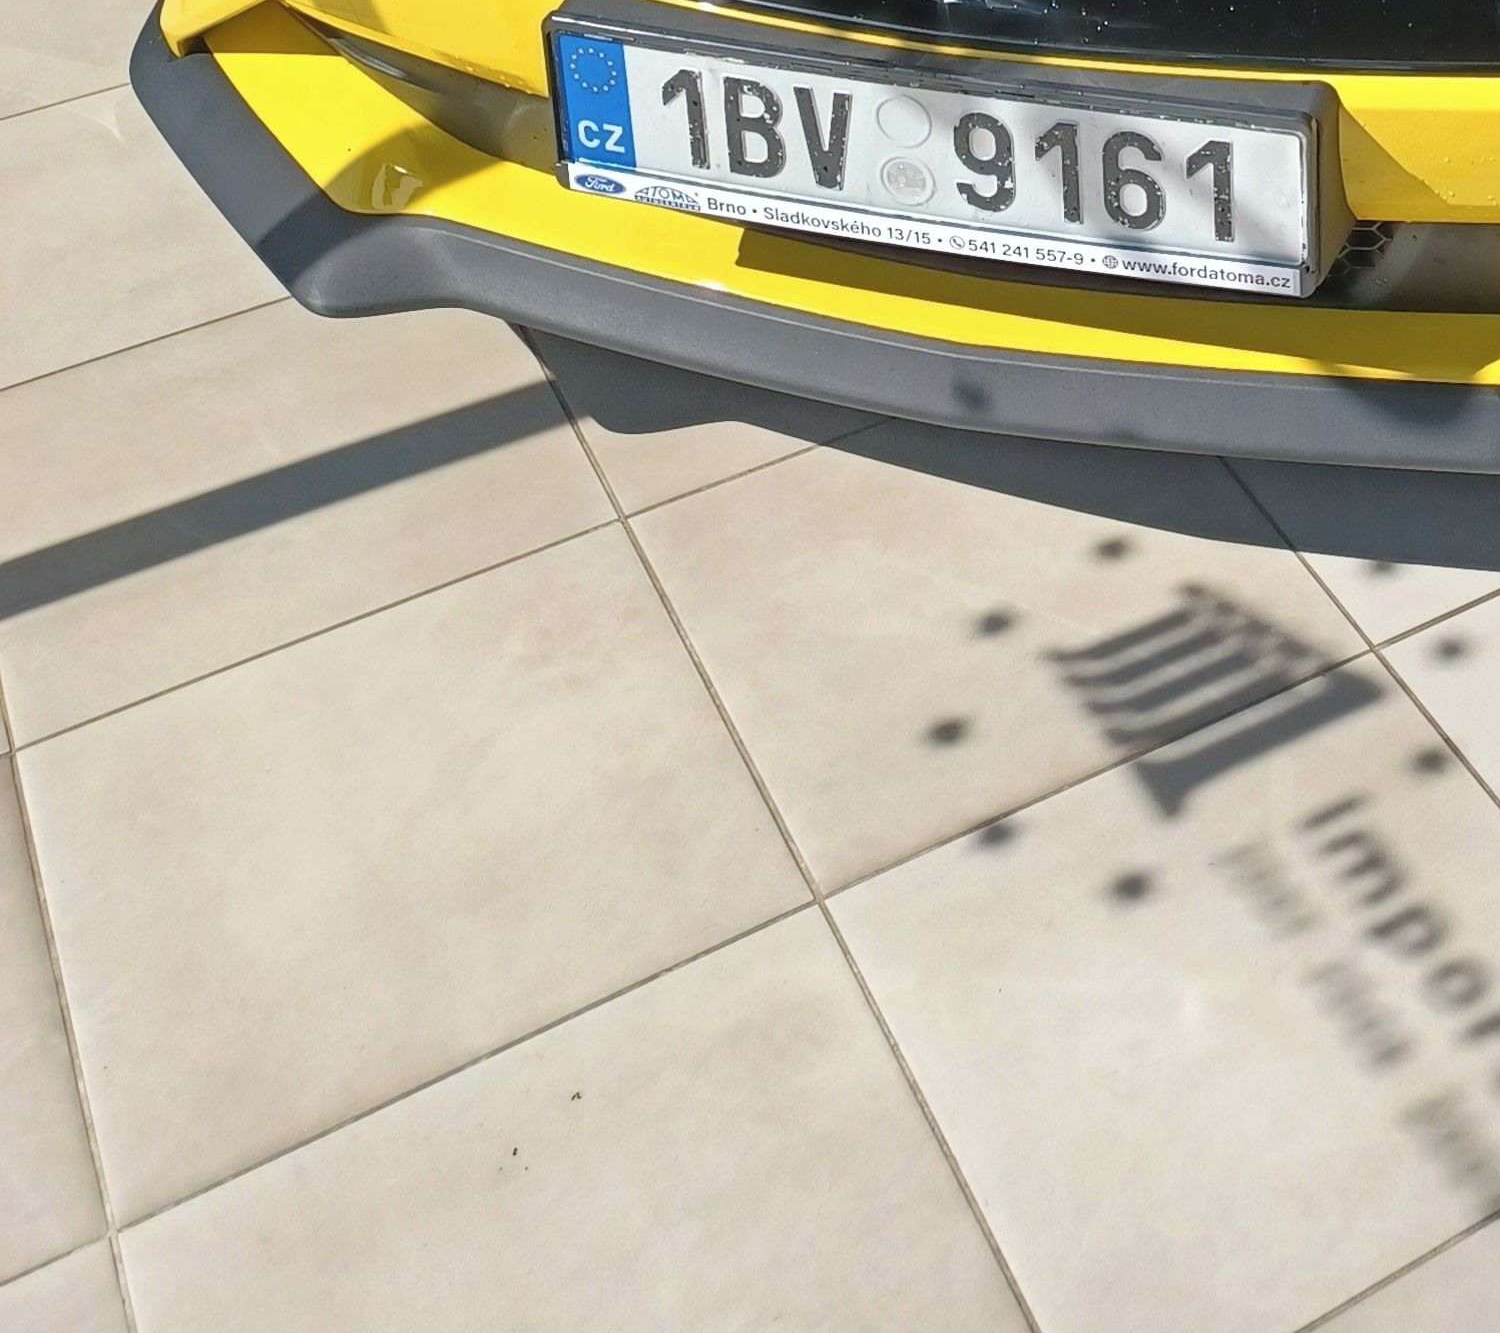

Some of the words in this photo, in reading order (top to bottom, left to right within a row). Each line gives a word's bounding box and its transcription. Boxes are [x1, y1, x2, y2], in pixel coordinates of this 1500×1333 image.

[577, 119, 626, 154] CZ
[662, 68, 853, 191] 1BV
[952, 111, 1234, 243] 9161
[580, 176, 618, 194] Ford
[707, 197, 746, 216] Brno
[764, 206, 881, 238] Sladkovského
[888, 227, 931, 245] 13/15
[968, 239, 996, 254] 541
[1002, 244, 1029, 259] 241
[1036, 248, 1084, 265] 557-9
[1122, 260, 1291, 289] www.fordatoma.cz
